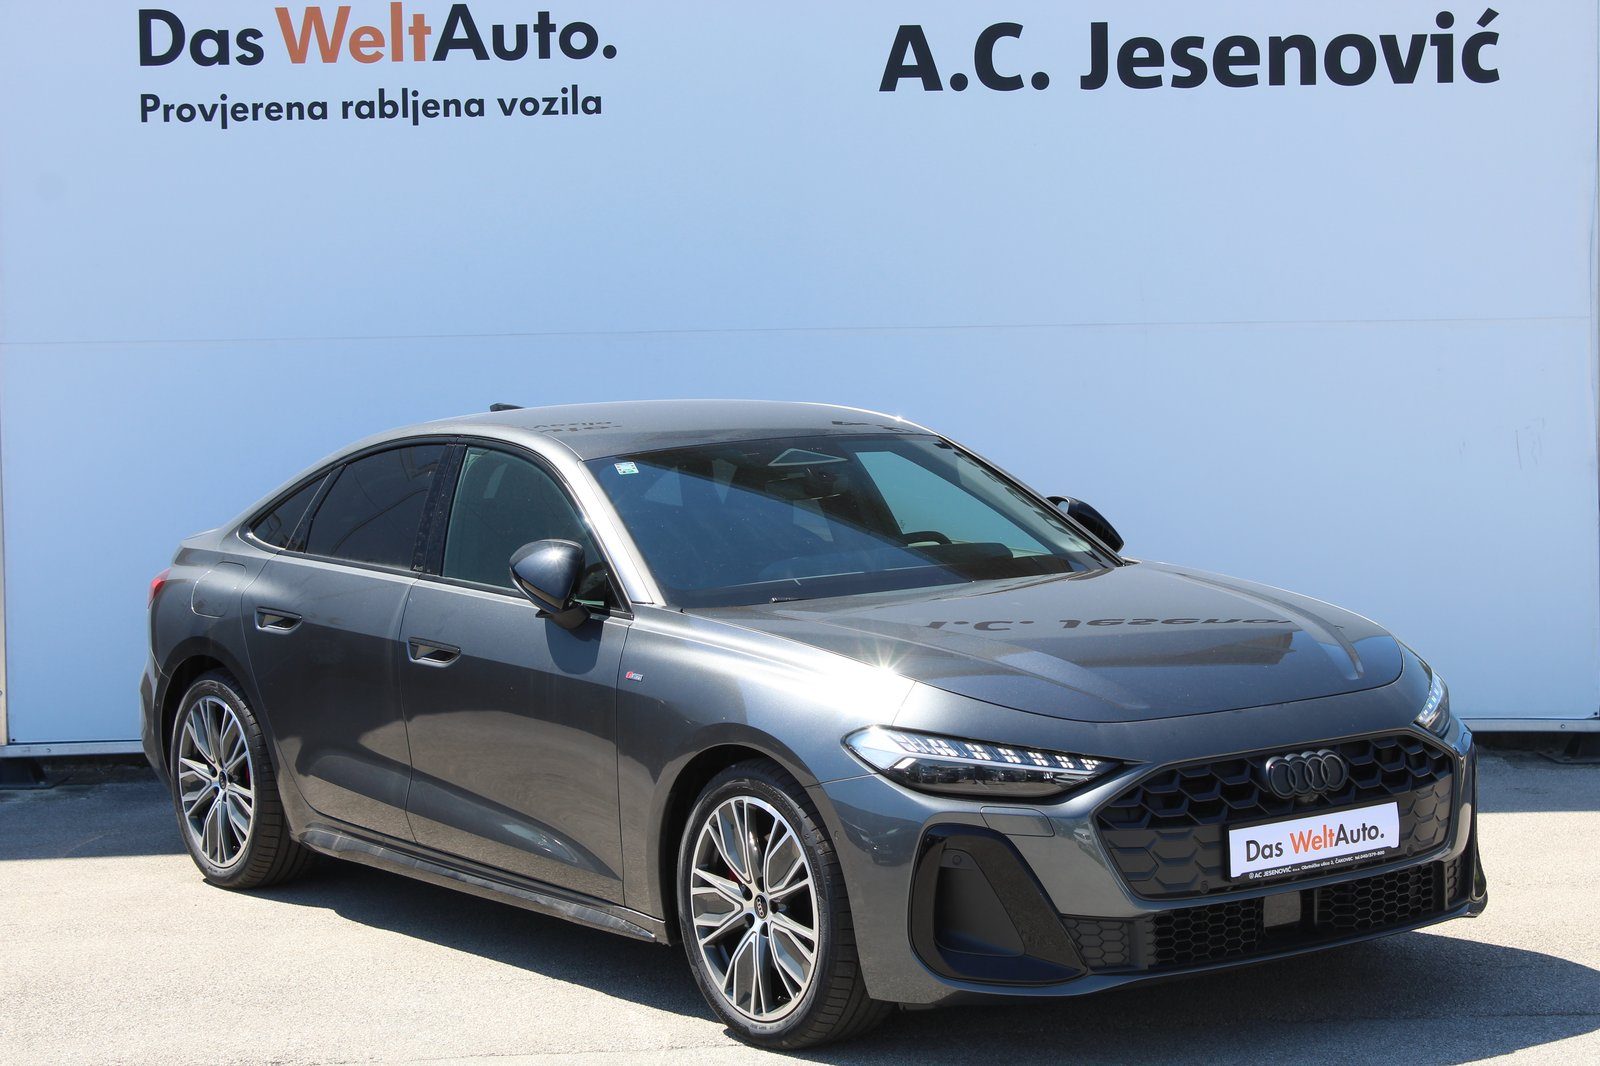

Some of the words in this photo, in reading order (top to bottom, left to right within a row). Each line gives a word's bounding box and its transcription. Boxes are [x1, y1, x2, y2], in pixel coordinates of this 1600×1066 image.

[139, 9, 264, 66] Das
[275, 2, 617, 63] WeltAuto.
[879, 22, 1049, 92] A.C.
[1080, 8, 1500, 90] Jesenović
[141, 94, 327, 129] Provjerena
[342, 88, 484, 126] rabljena
[497, 84, 601, 116] vozila
[1245, 840, 1283, 862] Das
[1289, 823, 1385, 855] WeltAuto.
